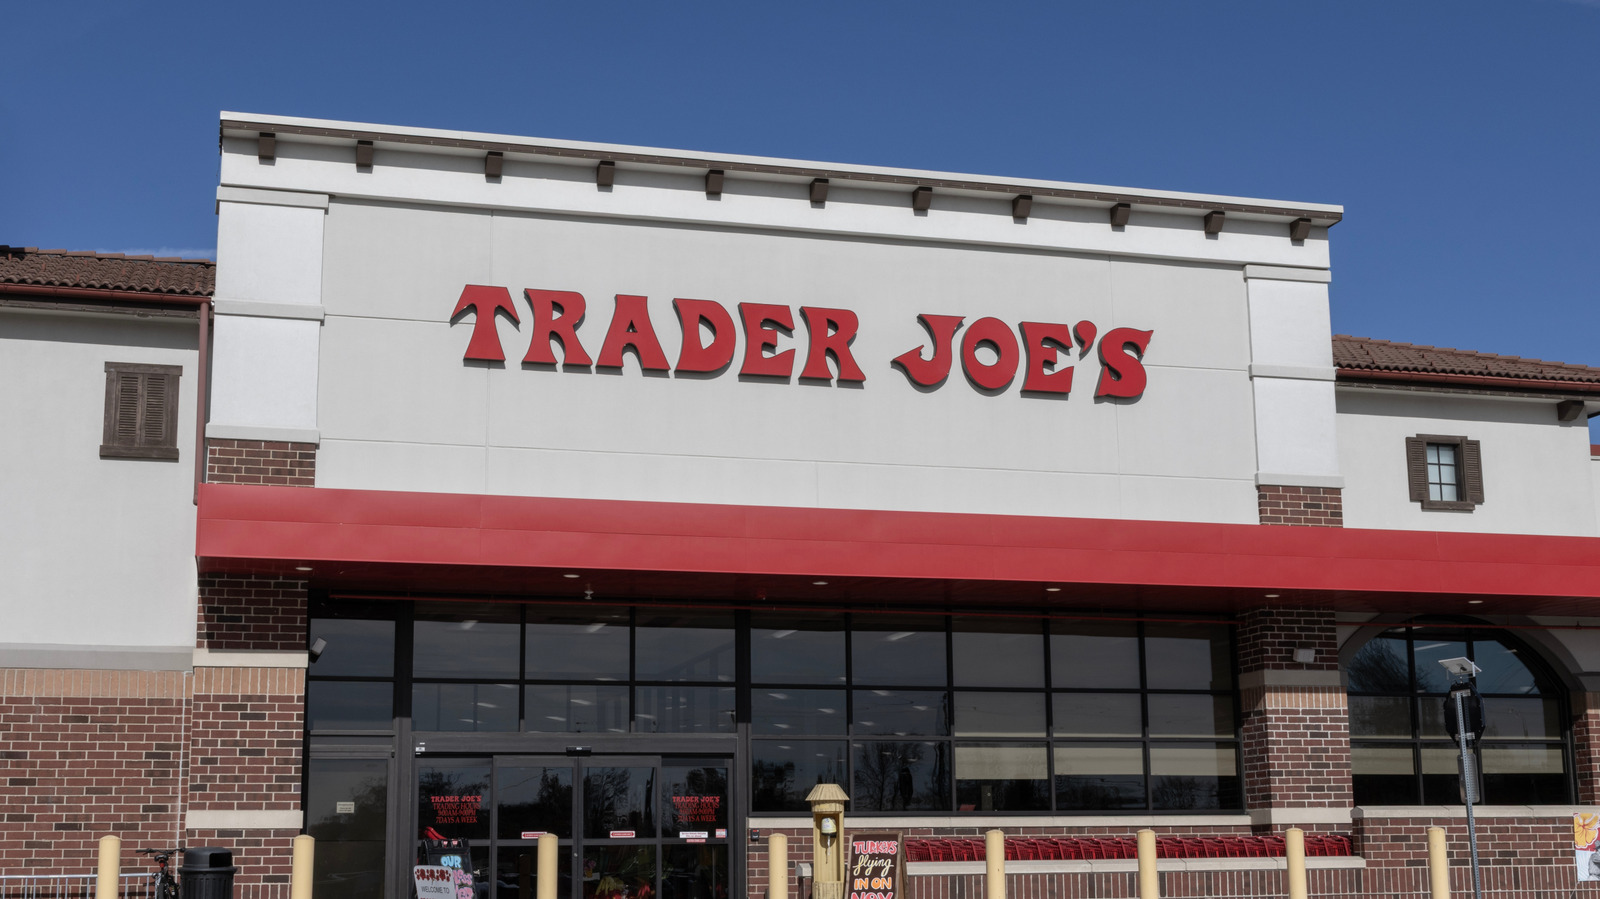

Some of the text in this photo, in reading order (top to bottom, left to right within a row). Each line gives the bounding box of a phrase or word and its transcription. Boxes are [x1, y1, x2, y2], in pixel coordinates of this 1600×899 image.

[450, 284, 1154, 399] TRADER JOE'S
[460, 816, 478, 824] WEEK
[440, 855, 462, 869] OUR
[852, 854, 895, 877] flying
[854, 877, 892, 890] IN ON
